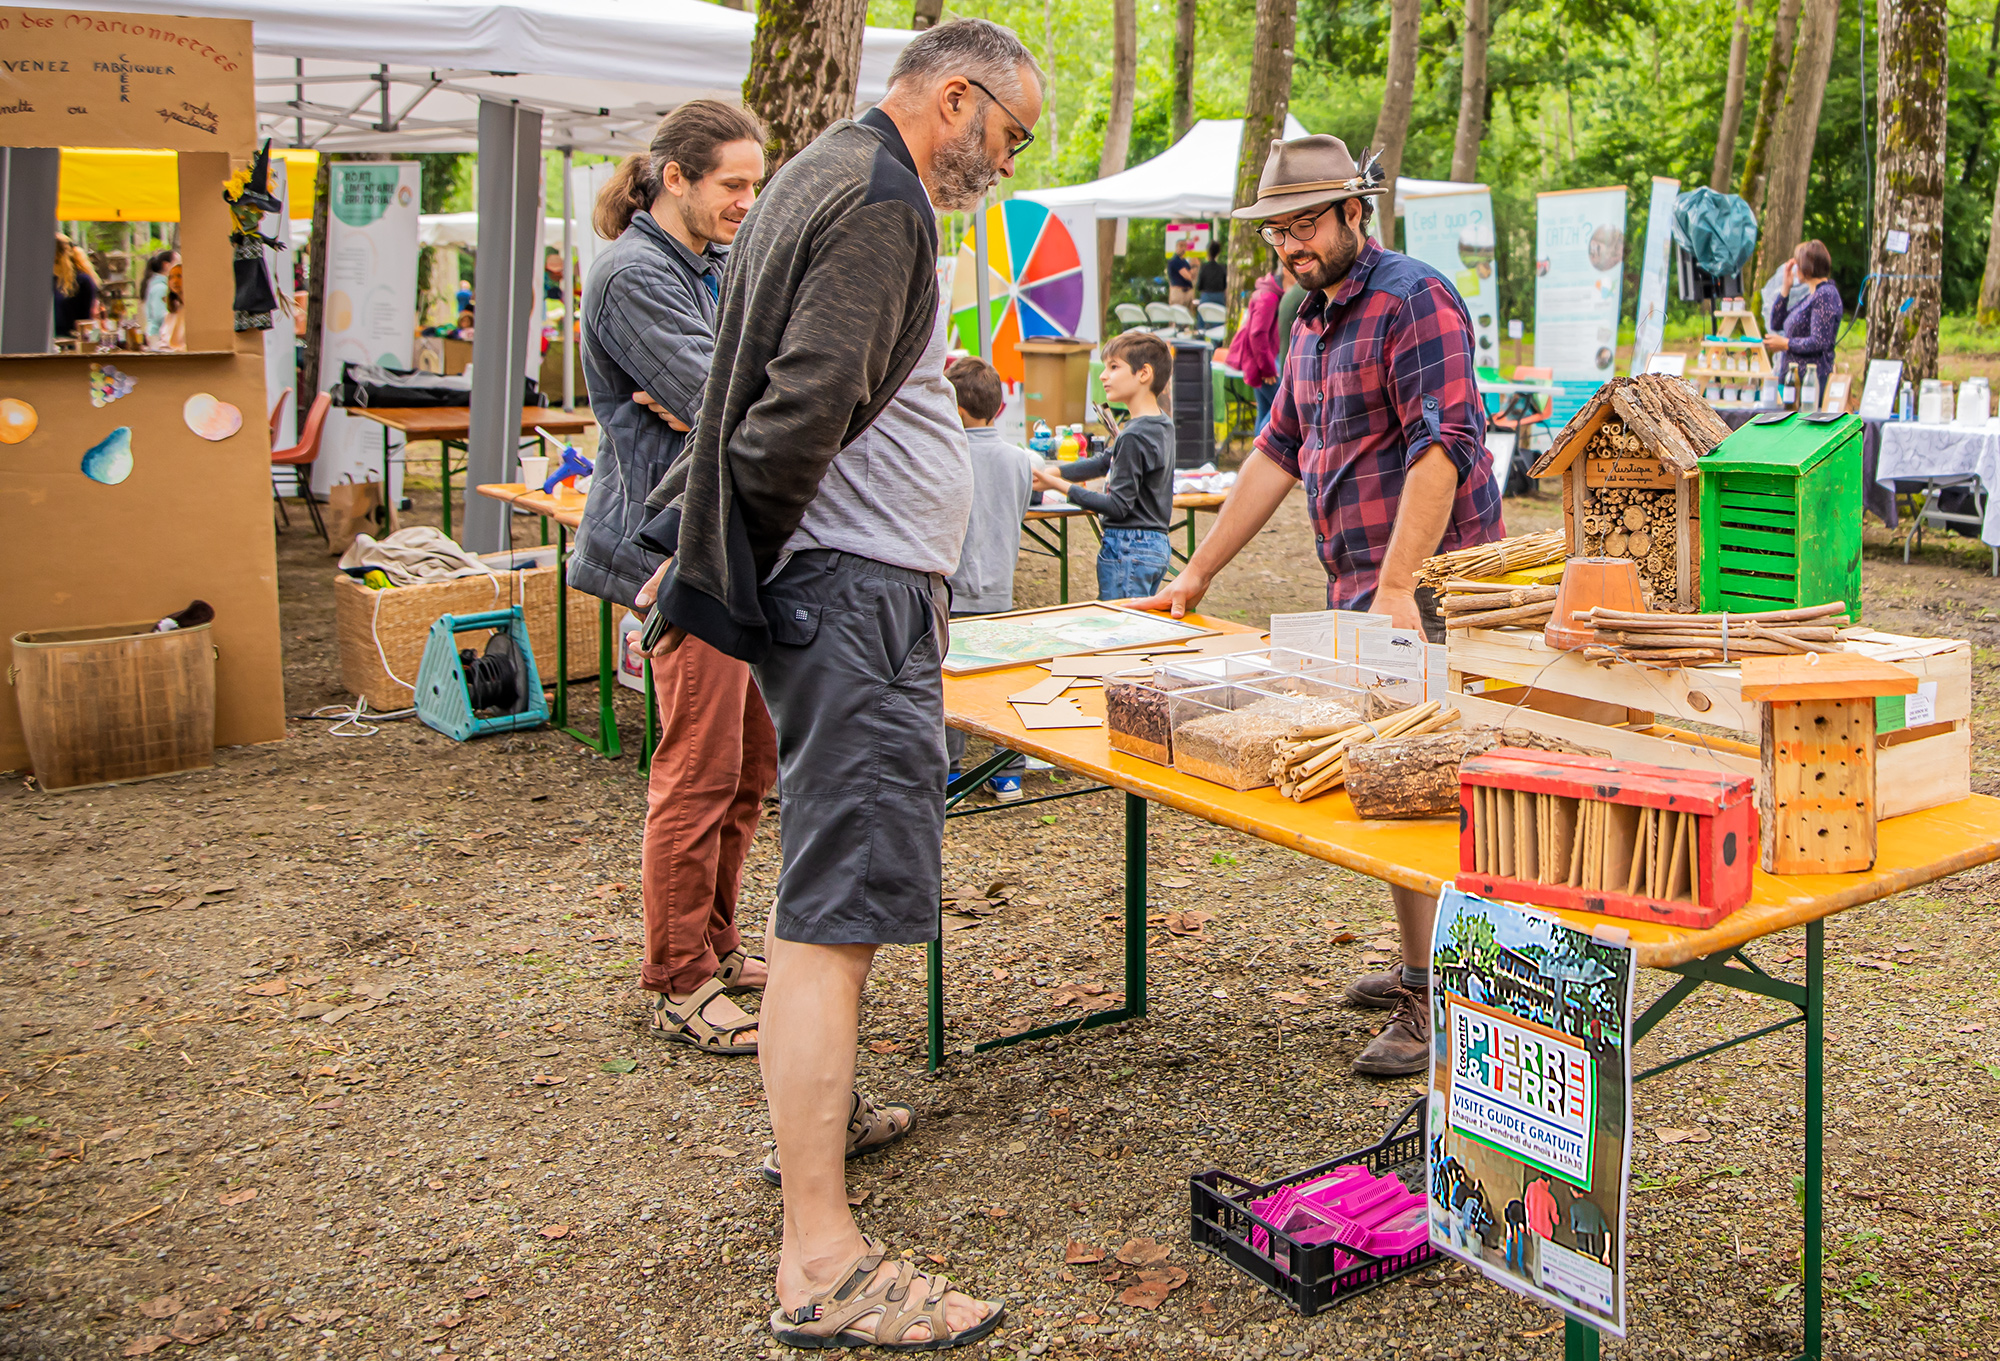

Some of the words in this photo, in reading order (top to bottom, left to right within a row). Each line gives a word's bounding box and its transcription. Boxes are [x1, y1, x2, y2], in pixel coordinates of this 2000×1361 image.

[3, 59, 70, 73] VENEZ
[93, 61, 176, 75] FABRIQUER
[21, 12, 54, 29] des
[64, 14, 239, 73] Marionnettes
[67, 106, 88, 115] ou
[181, 101, 219, 123] votre
[1597, 462, 1606, 473] Le
[1612, 461, 1653, 476] Rustique
[1456, 1014, 1467, 1077] Écocentre
[1467, 1019, 1584, 1090] PIERRE
[1466, 1057, 1483, 1083] &
[1482, 1053, 1585, 1125] TERRE
[1452, 1110, 1477, 1126] chaque
[1489, 1125, 1520, 1144] vendredi
[1522, 1138, 1531, 1149] du
[1533, 1144, 1550, 1156] mois
[1559, 1153, 1582, 1170] 15h30
[1454, 1094, 1484, 1117] VISITE
[1529, 1126, 1582, 1158] GRATUITE
